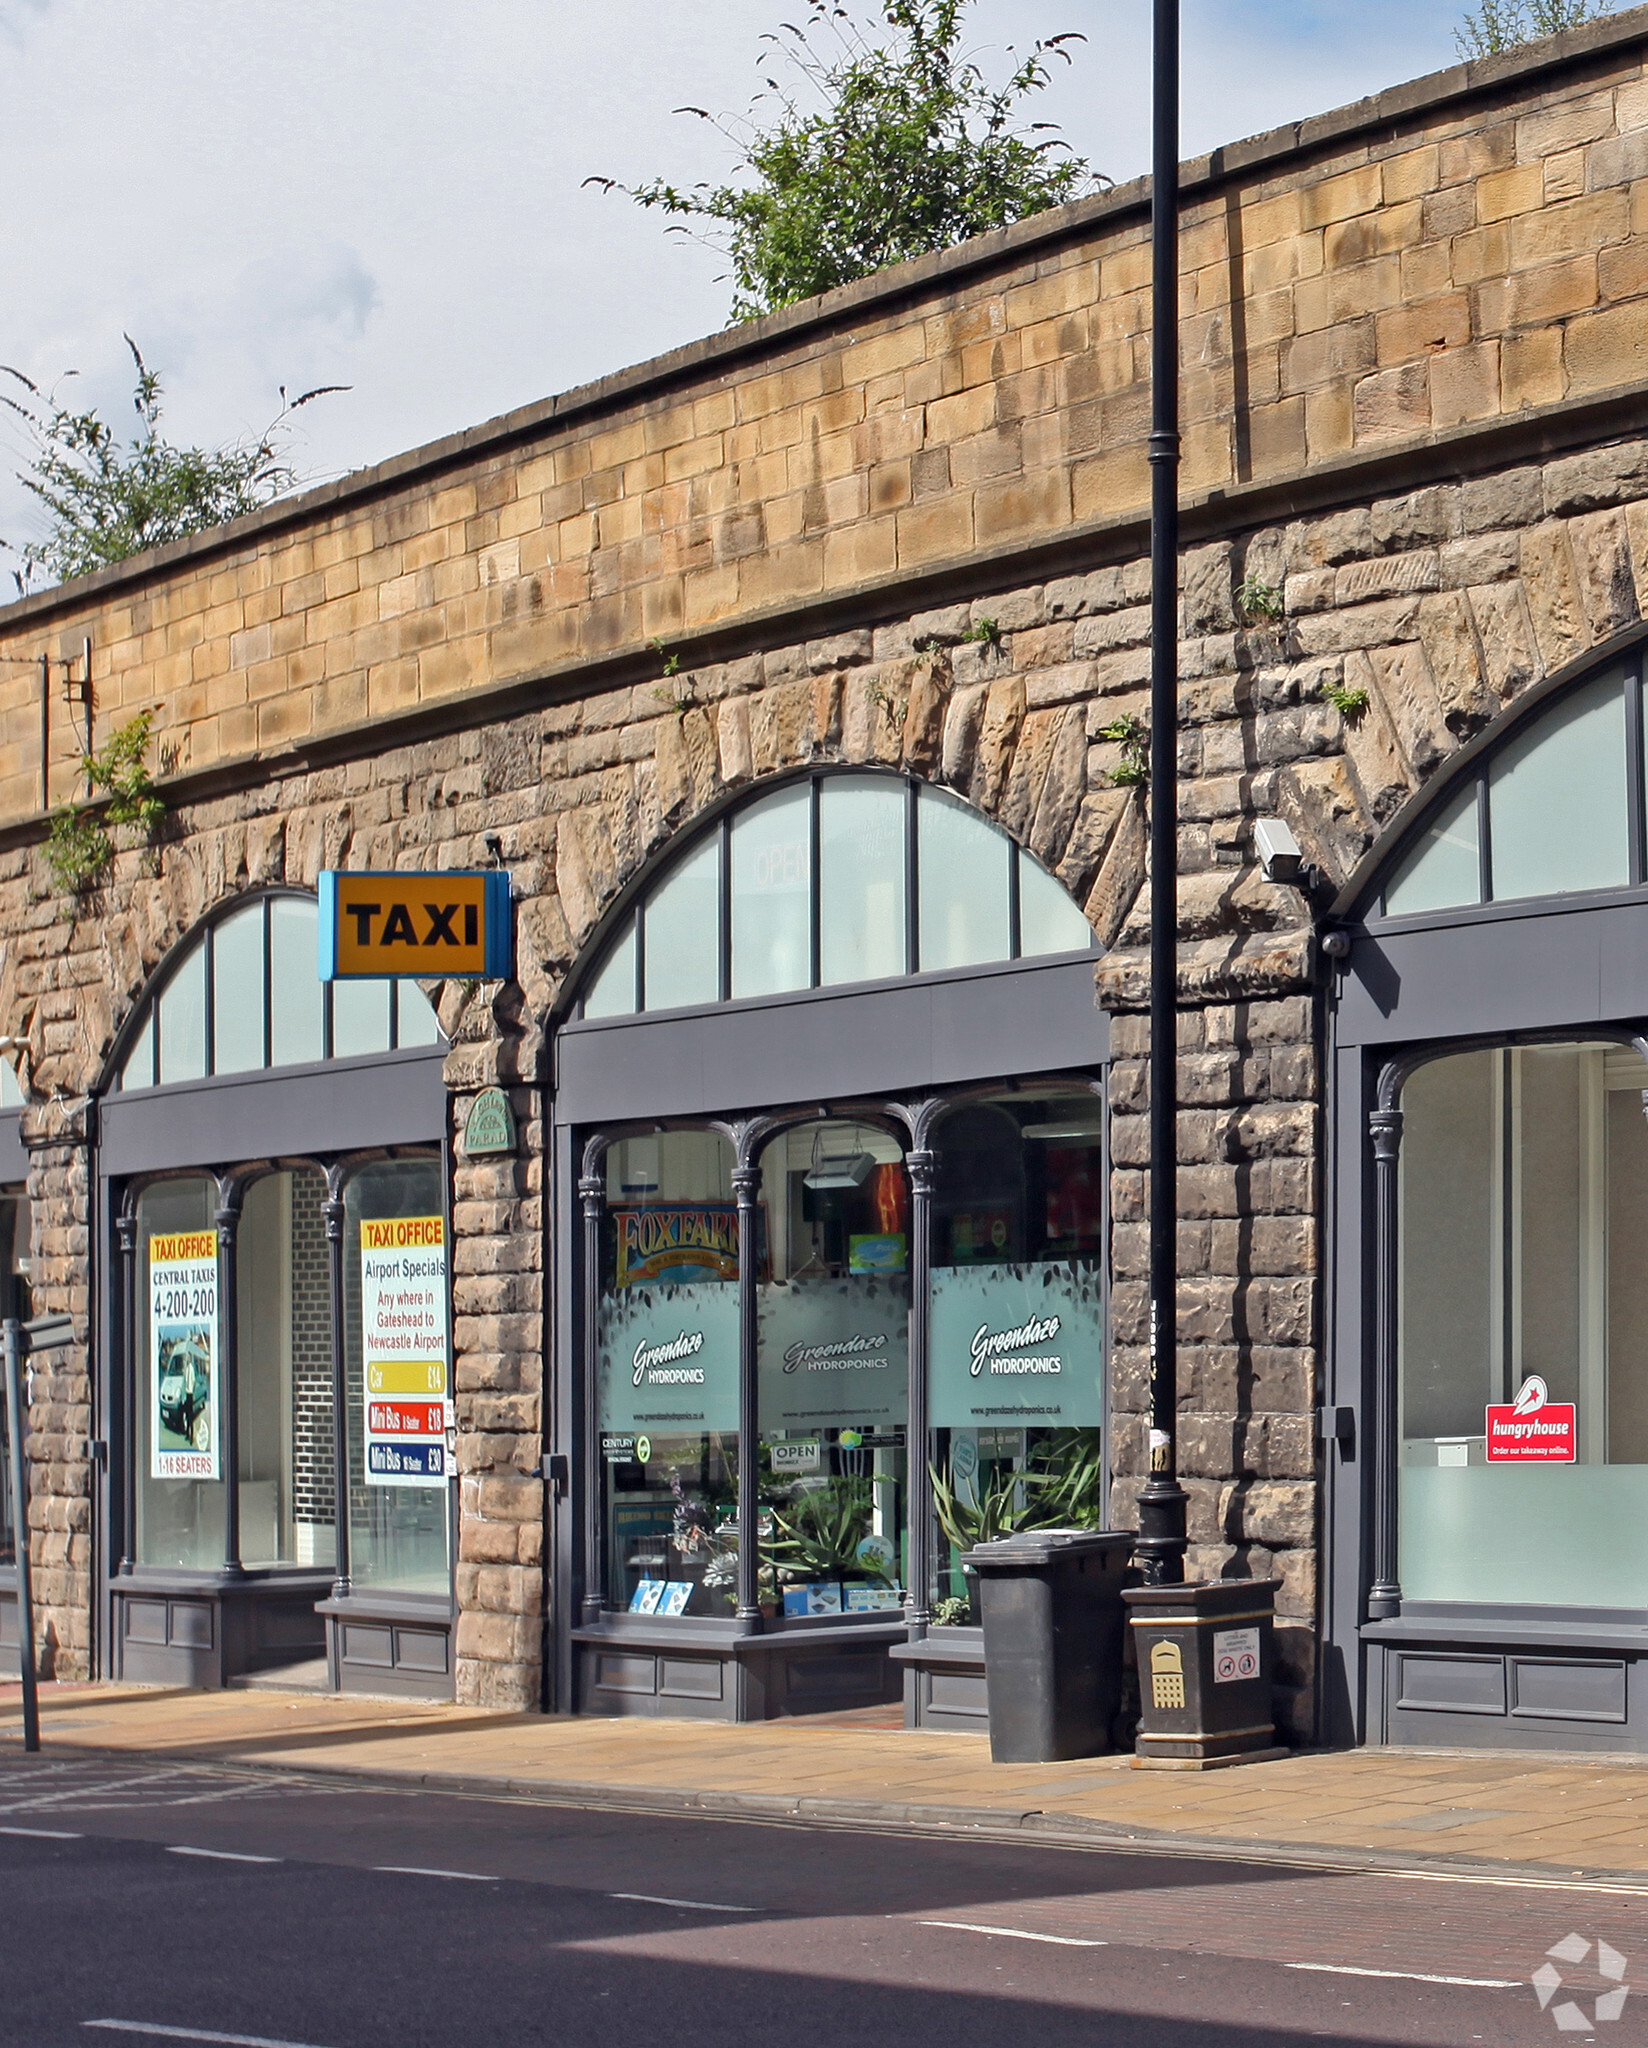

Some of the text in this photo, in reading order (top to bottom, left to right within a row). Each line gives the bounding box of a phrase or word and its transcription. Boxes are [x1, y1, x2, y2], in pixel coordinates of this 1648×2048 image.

[346, 903, 478, 946] TAXI
[367, 1220, 442, 1247] TAXI OFFICE
[155, 1235, 213, 1260] TAXI OFFICE
[153, 1267, 215, 1286] CENTRAL TAXIS
[365, 1258, 447, 1283] Airport Specials
[377, 1289, 434, 1311] Any where in
[376, 1311, 435, 1328] Gateshead to
[367, 1331, 445, 1353] Newcastle Airport
[970, 1313, 1062, 1378] Greendaze
[632, 1329, 704, 1387] Greendaze
[783, 1334, 889, 1374] Greendaze
[807, 1358, 888, 1371] HYDROPONICS
[648, 1368, 705, 1384] HYDROPONICS
[990, 1356, 1062, 1375] HYDROPONICS
[370, 1365, 442, 1389] Car £14
[371, 1406, 386, 1430] Mini
[386, 1406, 401, 1430] Bus
[428, 1407, 442, 1431] £18
[970, 1405, 1062, 1416] www.greendazehydroponics.co.uk
[1492, 1418, 1569, 1439] hungryhouse
[602, 1438, 634, 1448] CENTURY
[776, 1445, 815, 1459] OPEN
[1492, 1446, 1509, 1455] Order
[1521, 1446, 1548, 1456] takeaway
[1548, 1445, 1569, 1455] online.
[159, 1456, 212, 1474] 1-16 SEATERS
[371, 1447, 386, 1470] Mini
[386, 1447, 401, 1470] Bus
[428, 1448, 442, 1472] £30
